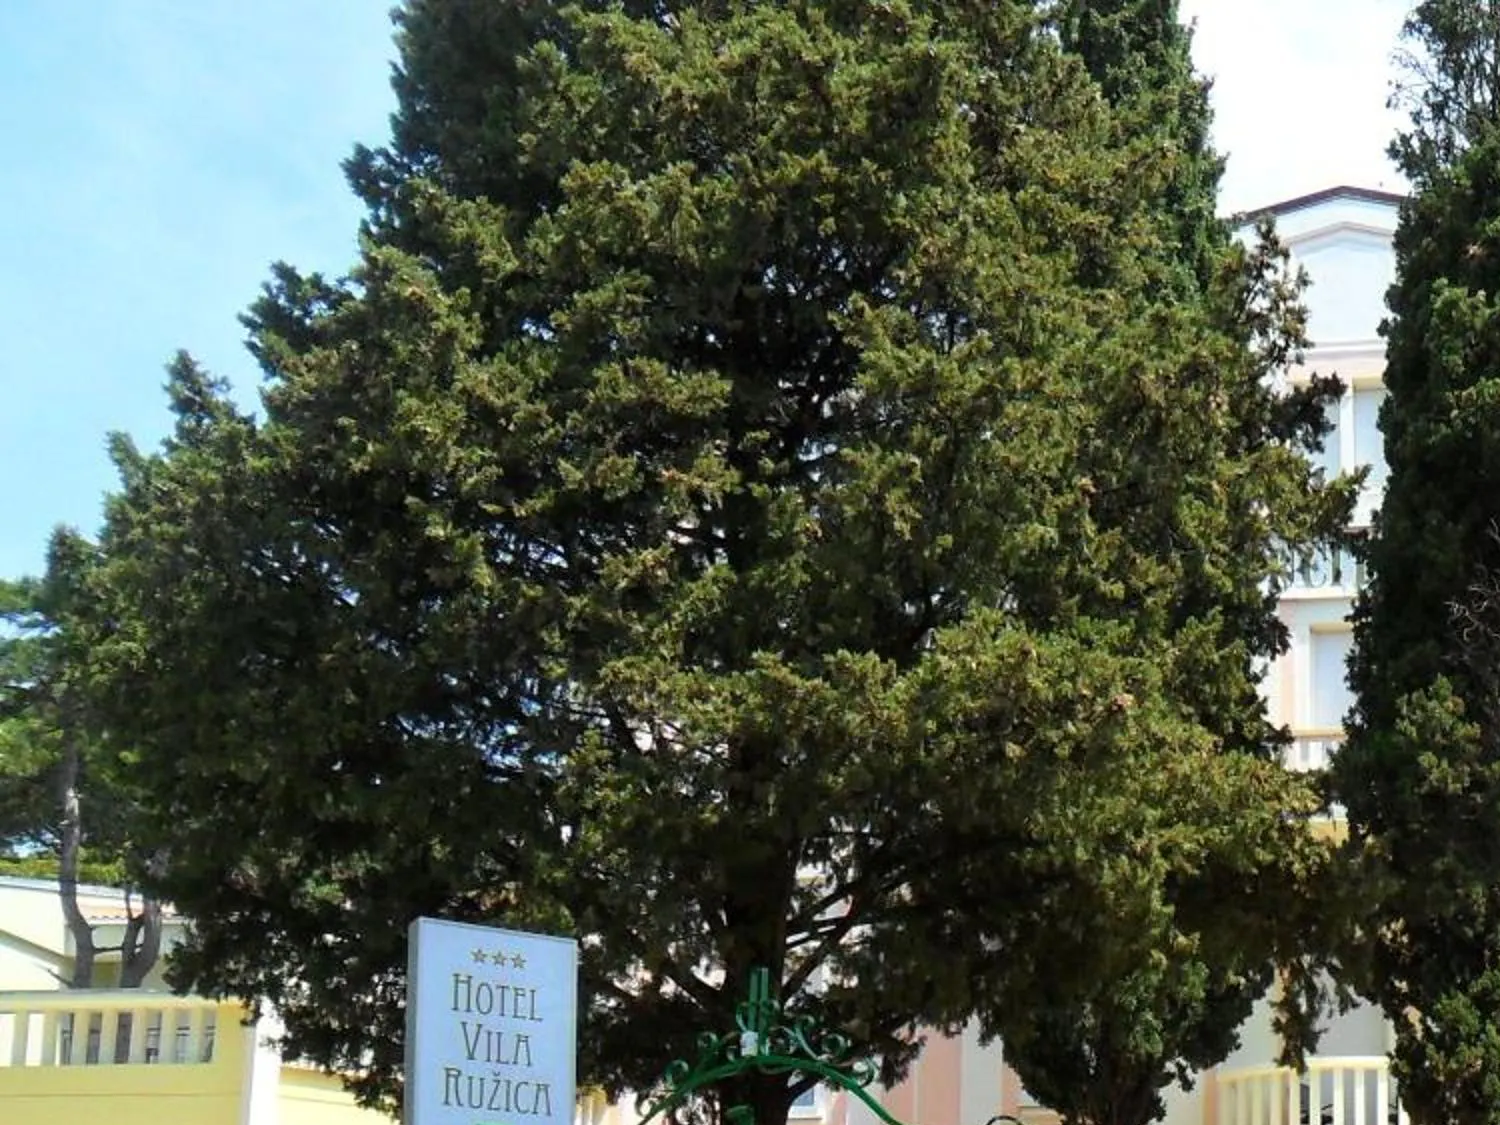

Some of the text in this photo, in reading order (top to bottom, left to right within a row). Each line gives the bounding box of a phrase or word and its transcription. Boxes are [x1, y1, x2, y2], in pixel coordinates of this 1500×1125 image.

[450, 972, 544, 1022] HOTEL
[460, 1021, 533, 1068] VILA
[442, 1066, 553, 1117] RUŽICA
